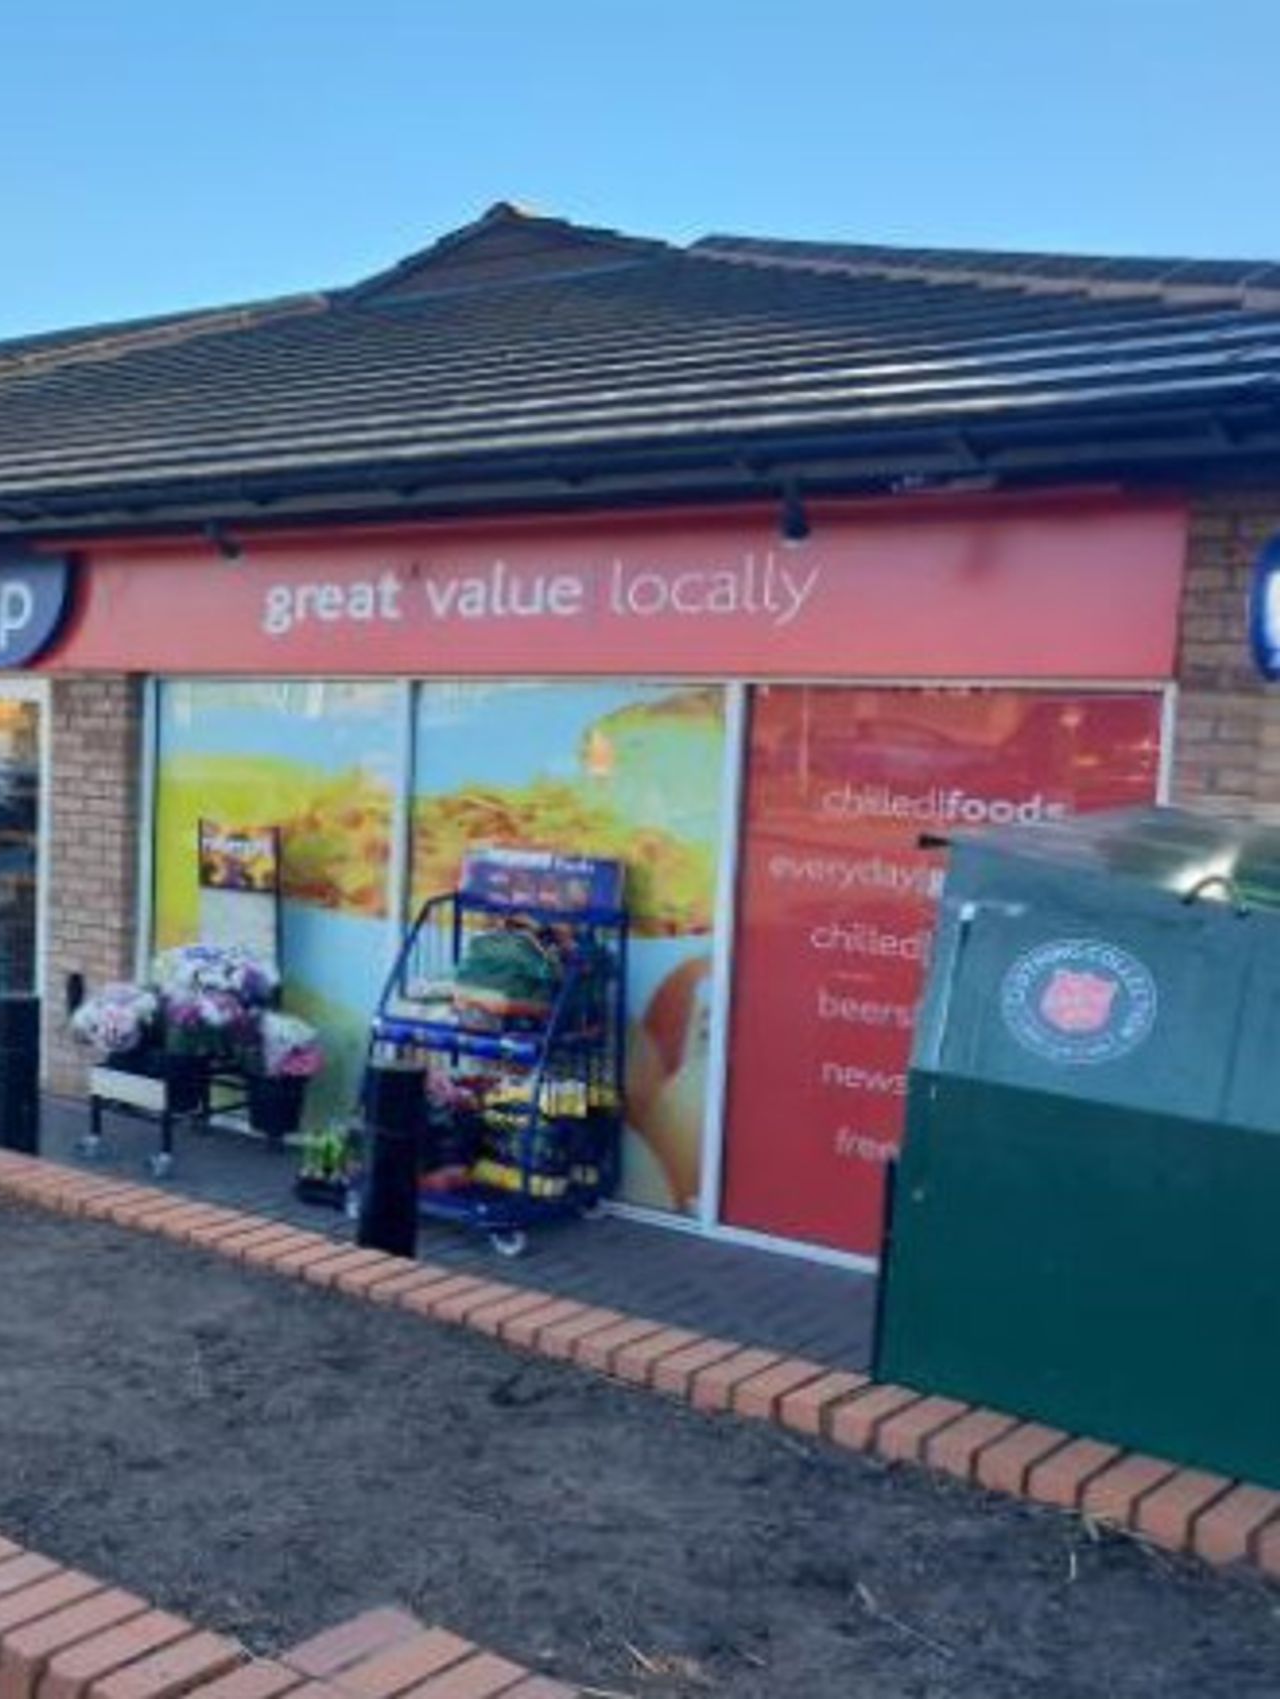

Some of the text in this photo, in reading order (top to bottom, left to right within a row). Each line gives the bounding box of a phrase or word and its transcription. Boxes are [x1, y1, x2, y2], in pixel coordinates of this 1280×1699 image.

[263, 551, 820, 634] great value locally
[810, 923, 923, 960] chilled
[817, 986, 914, 1029] beers
